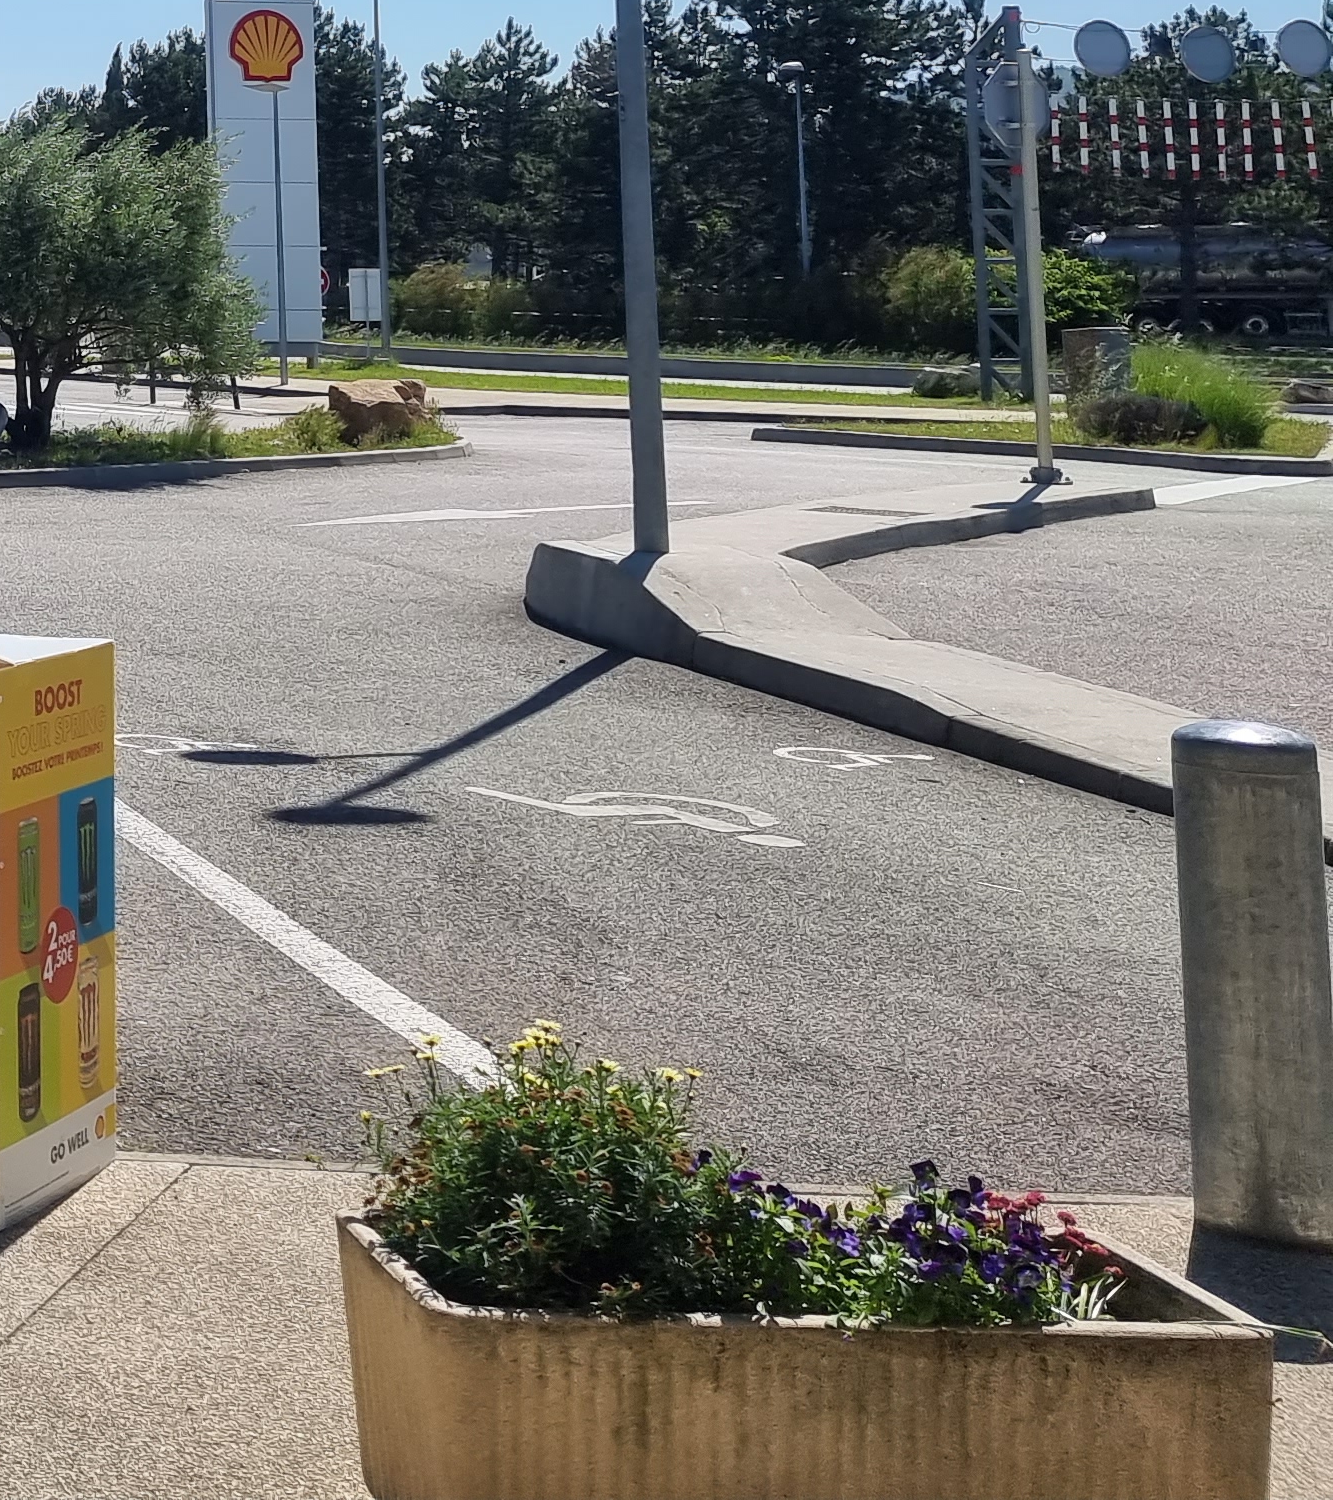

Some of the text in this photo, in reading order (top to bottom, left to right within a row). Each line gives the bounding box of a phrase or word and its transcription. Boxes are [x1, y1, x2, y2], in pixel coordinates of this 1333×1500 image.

[34, 679, 83, 716] BOOST
[6, 704, 107, 758] YOUR SPRING
[12, 760, 43, 781] BOOSTEZ
[47, 920, 58, 953] 2
[58, 929, 76, 947] POUR
[42, 945, 74, 984] 4,50€
[50, 1127, 90, 1164] GO WELL
